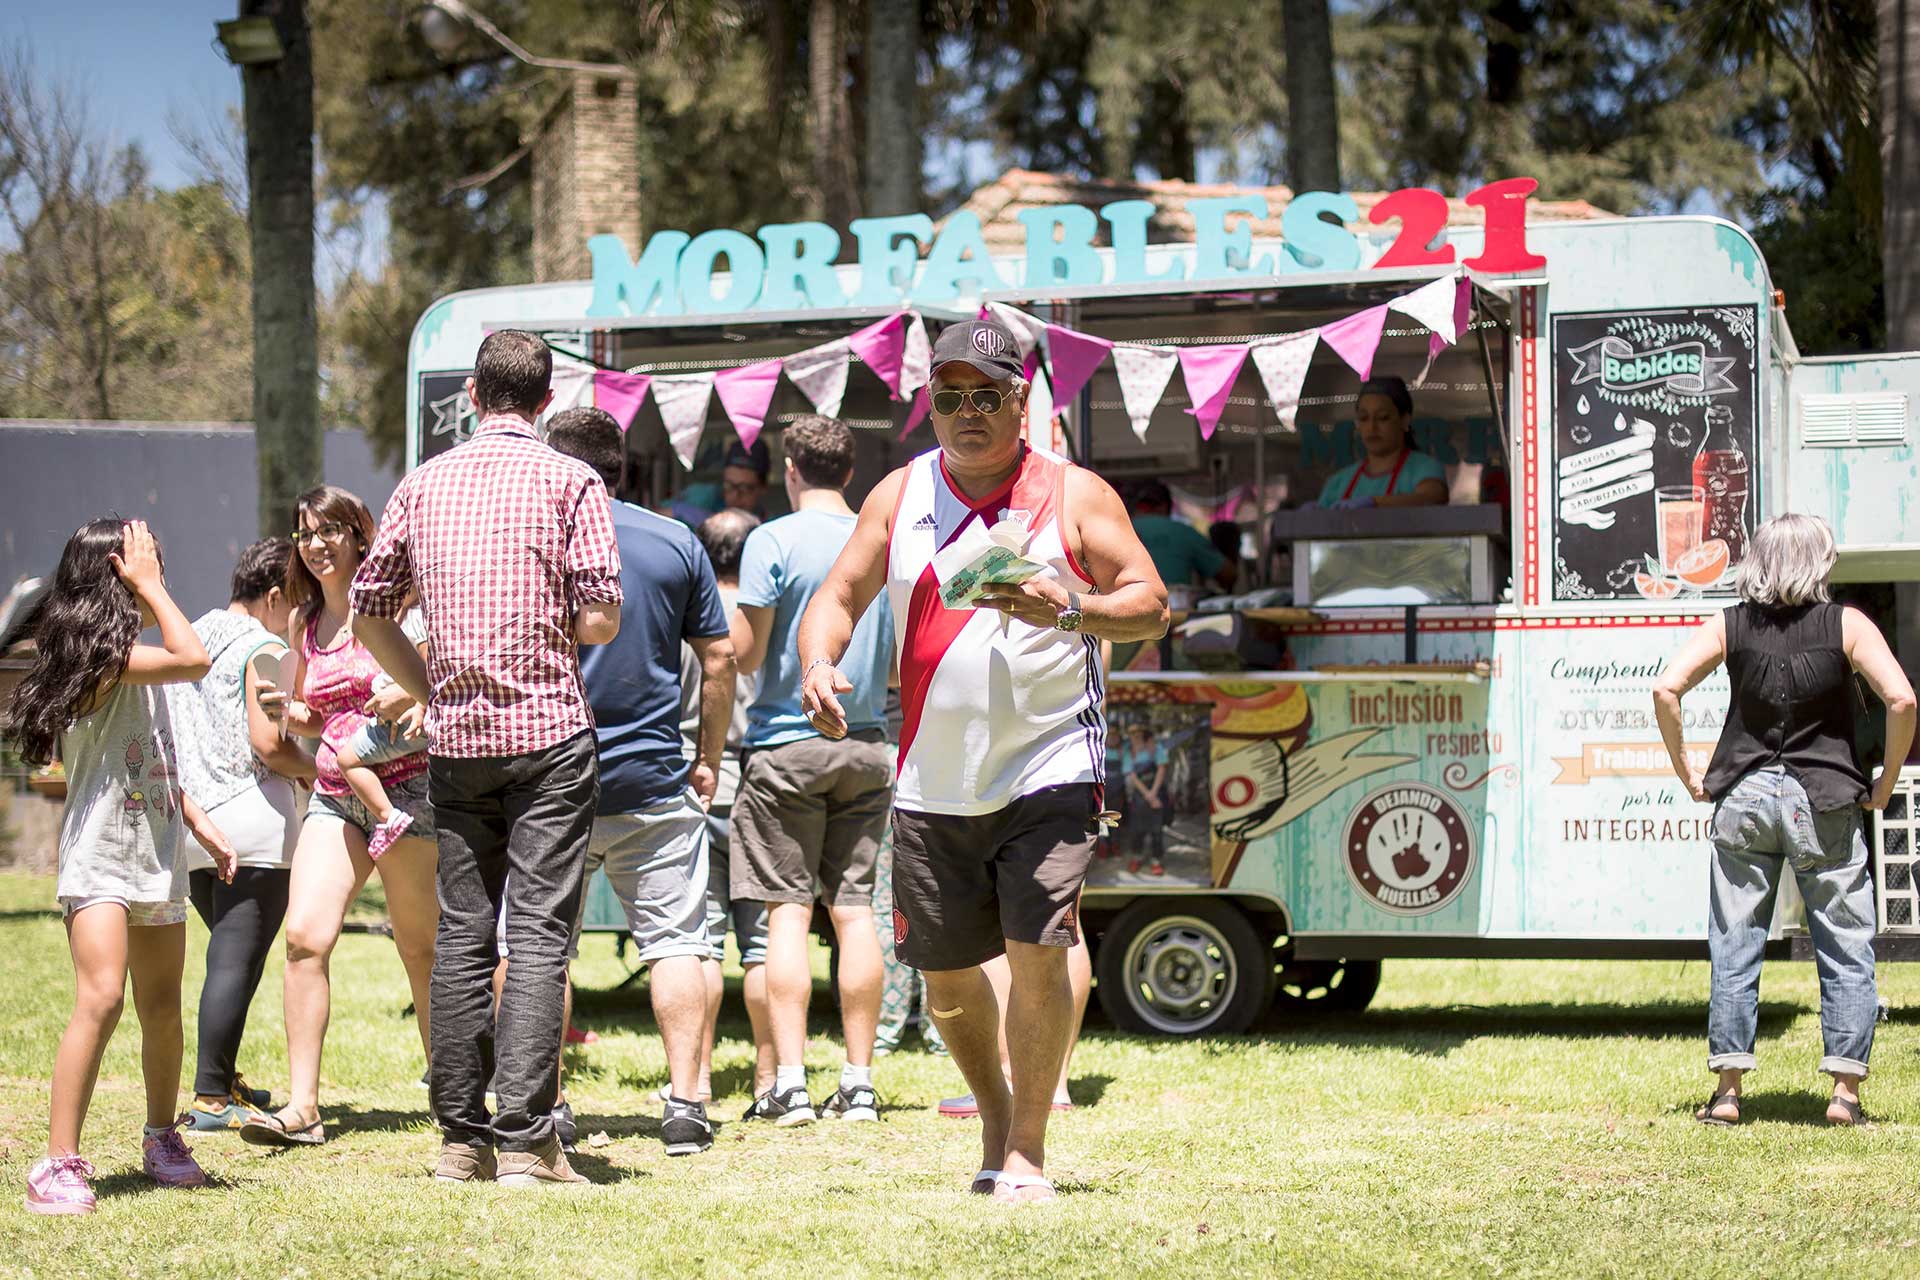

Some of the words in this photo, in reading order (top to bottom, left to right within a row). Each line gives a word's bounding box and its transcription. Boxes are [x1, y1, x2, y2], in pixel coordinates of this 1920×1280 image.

[586, 190, 1361, 317] MORFABLES
[1369, 177, 1547, 272] 21
[1605, 352, 1701, 383] Bebidas
[1550, 656, 1668, 686] Comprend
[1350, 686, 1463, 724] inclusión
[1427, 728, 1502, 758] respeto
[1372, 789, 1443, 815] DEJANDO
[1622, 792, 1651, 811] por
[1657, 789, 1675, 804] la
[1375, 884, 1441, 906] HUELLAS
[443, 1158, 463, 1168] NIKE
